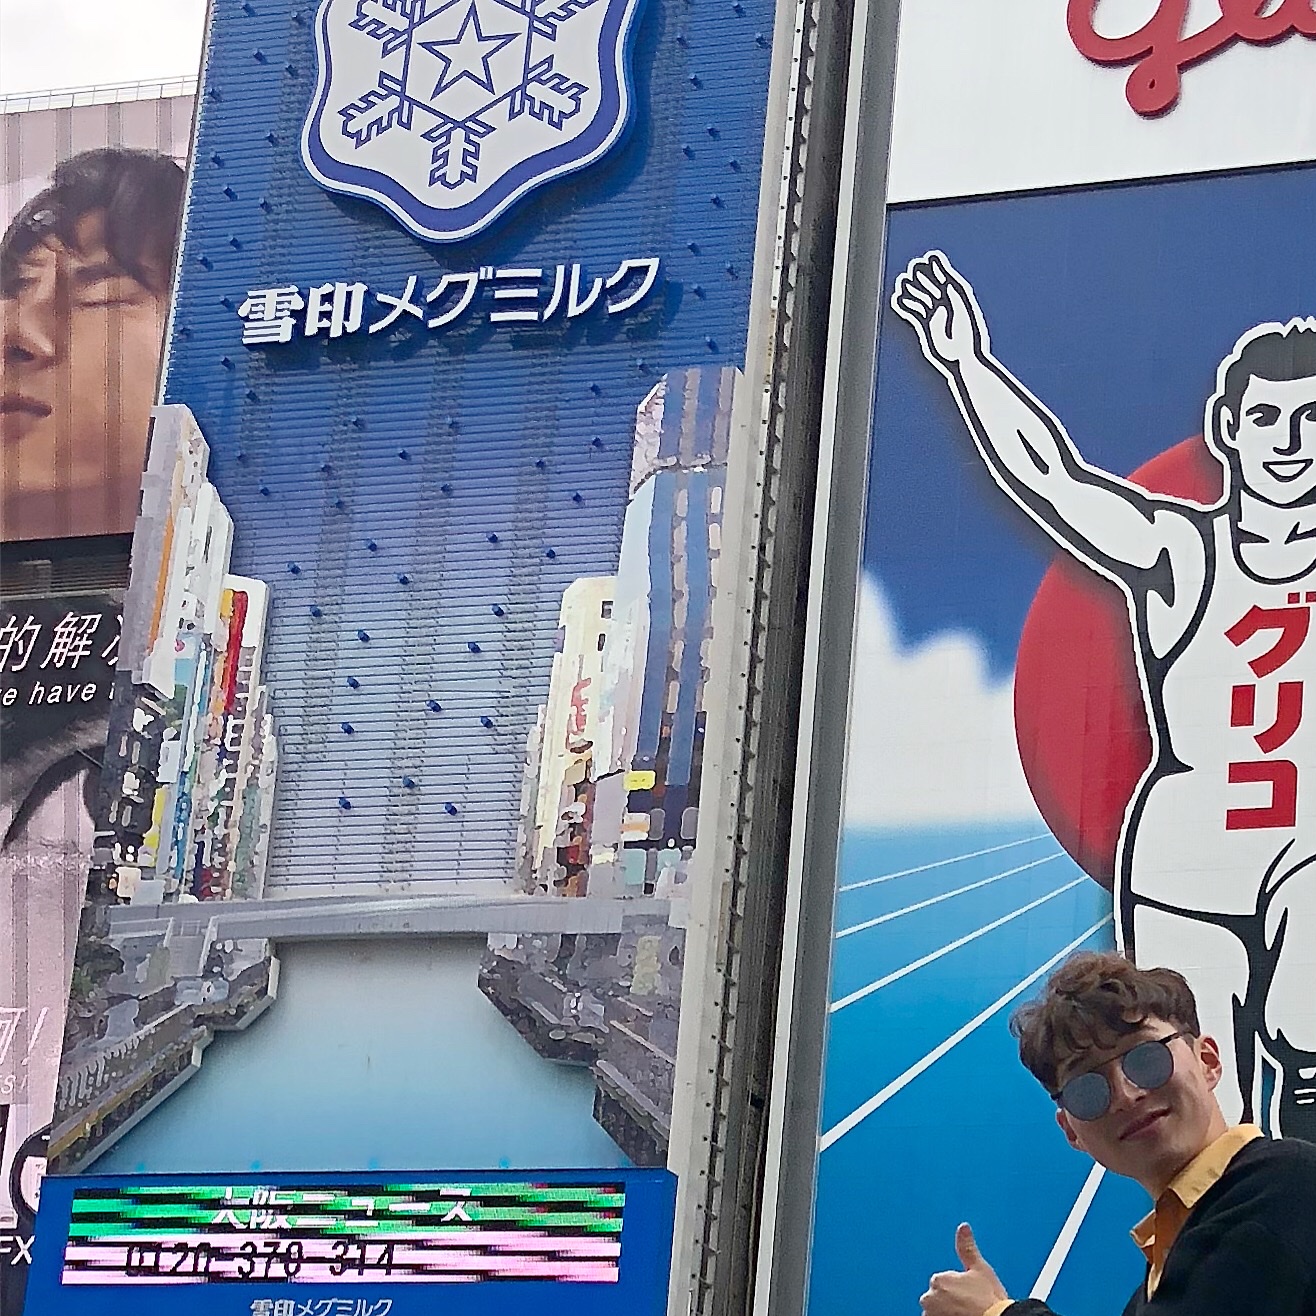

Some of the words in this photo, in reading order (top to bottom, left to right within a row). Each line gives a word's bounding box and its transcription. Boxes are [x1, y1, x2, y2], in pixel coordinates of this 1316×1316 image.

[237, 257, 660, 347] 雪印メグミルク
[0, 687, 18, 706] e
[28, 681, 97, 705] have
[211, 1185, 473, 1230] 大阪ニュース
